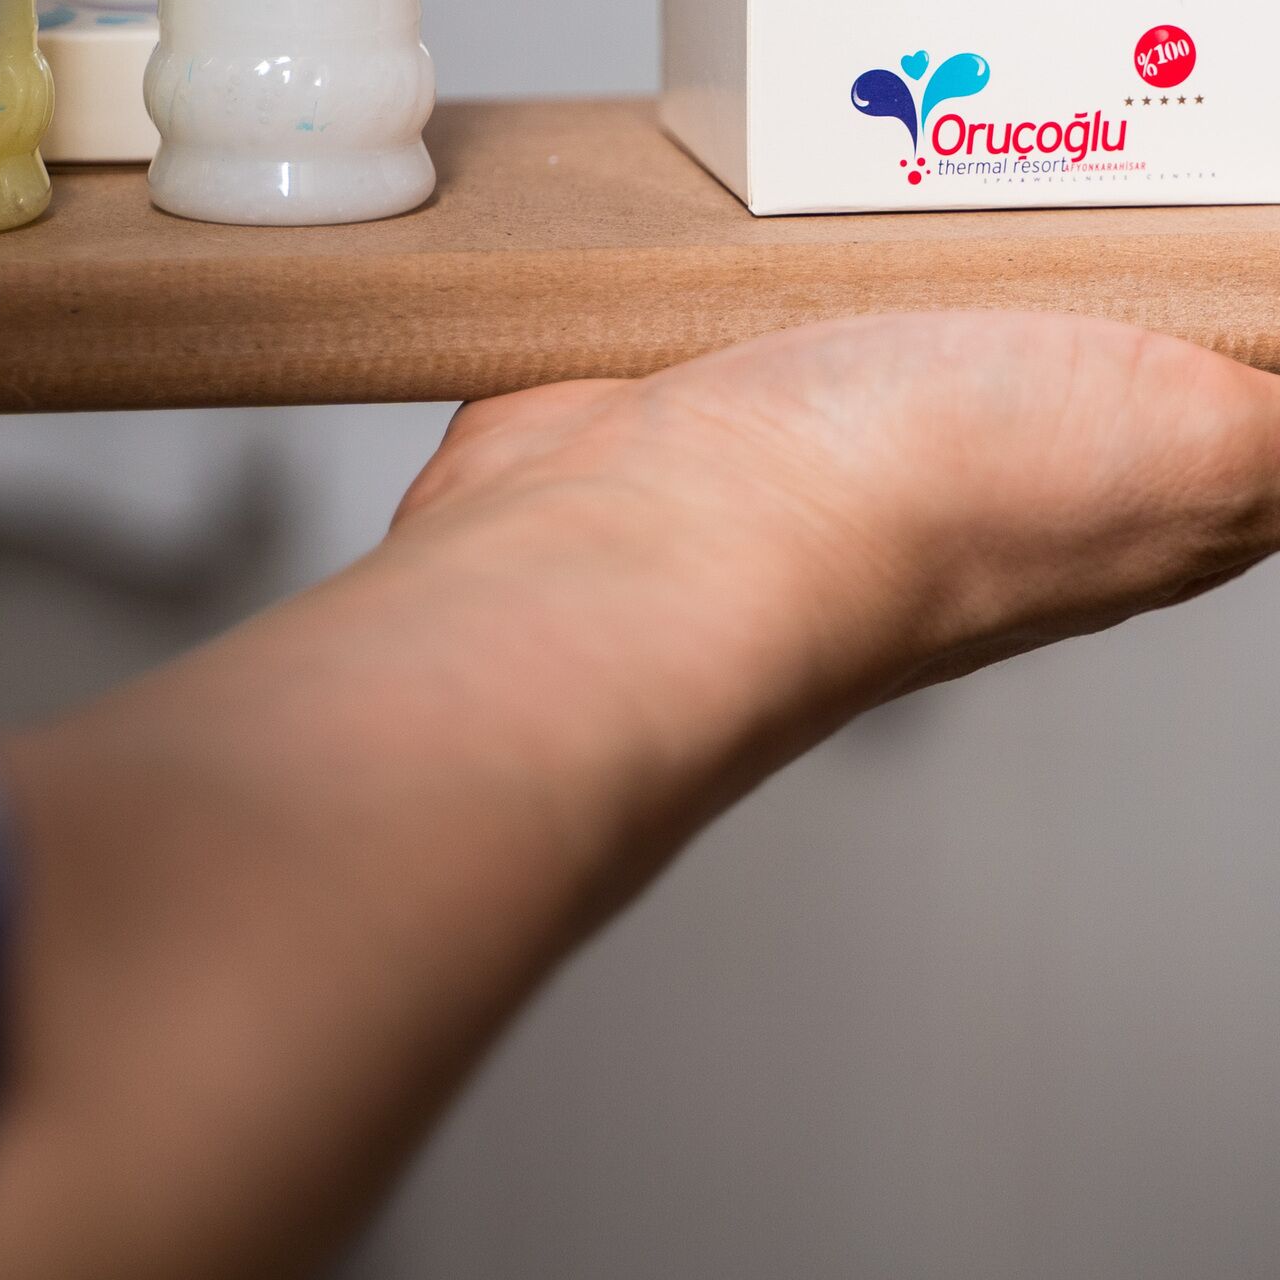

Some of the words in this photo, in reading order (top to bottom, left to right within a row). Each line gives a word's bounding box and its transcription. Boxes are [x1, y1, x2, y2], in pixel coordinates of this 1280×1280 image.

[1137, 39, 1190, 78] %100
[931, 110, 1127, 162] Oruçoğlu
[938, 158, 1008, 176] thermal
[1013, 156, 1067, 173] resort
